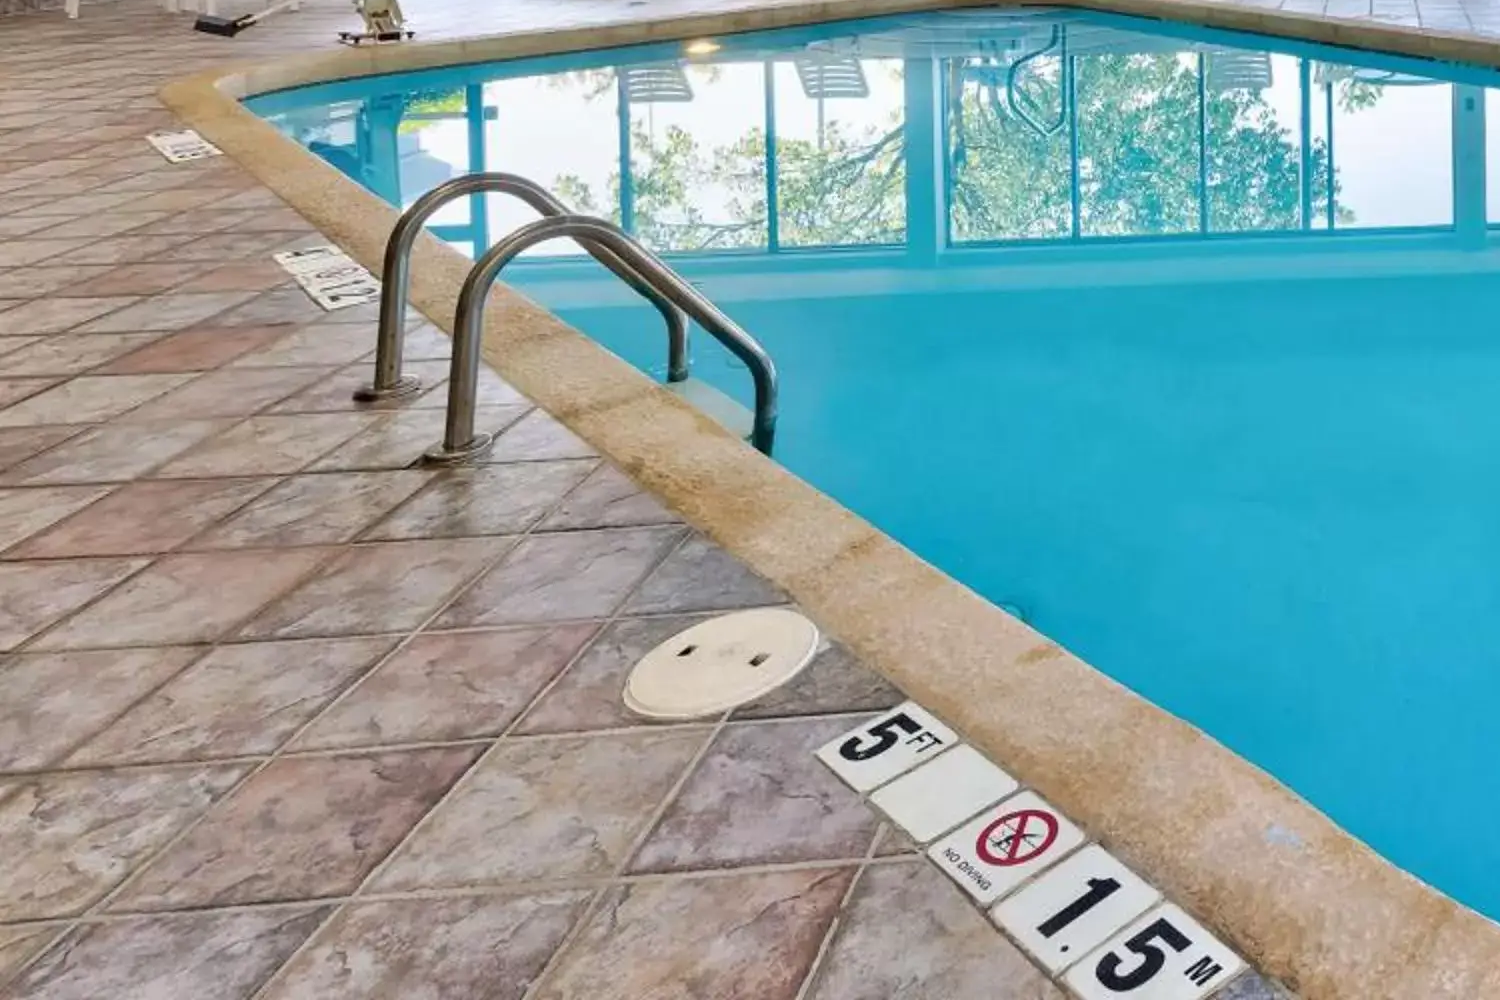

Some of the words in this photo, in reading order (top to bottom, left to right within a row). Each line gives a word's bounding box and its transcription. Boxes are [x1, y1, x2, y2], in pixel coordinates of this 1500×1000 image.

[839, 712, 924, 762] 5
[905, 730, 944, 755] FT
[943, 848, 961, 863] NO
[957, 861, 992, 891] DIVING
[1183, 955, 1224, 988] M
